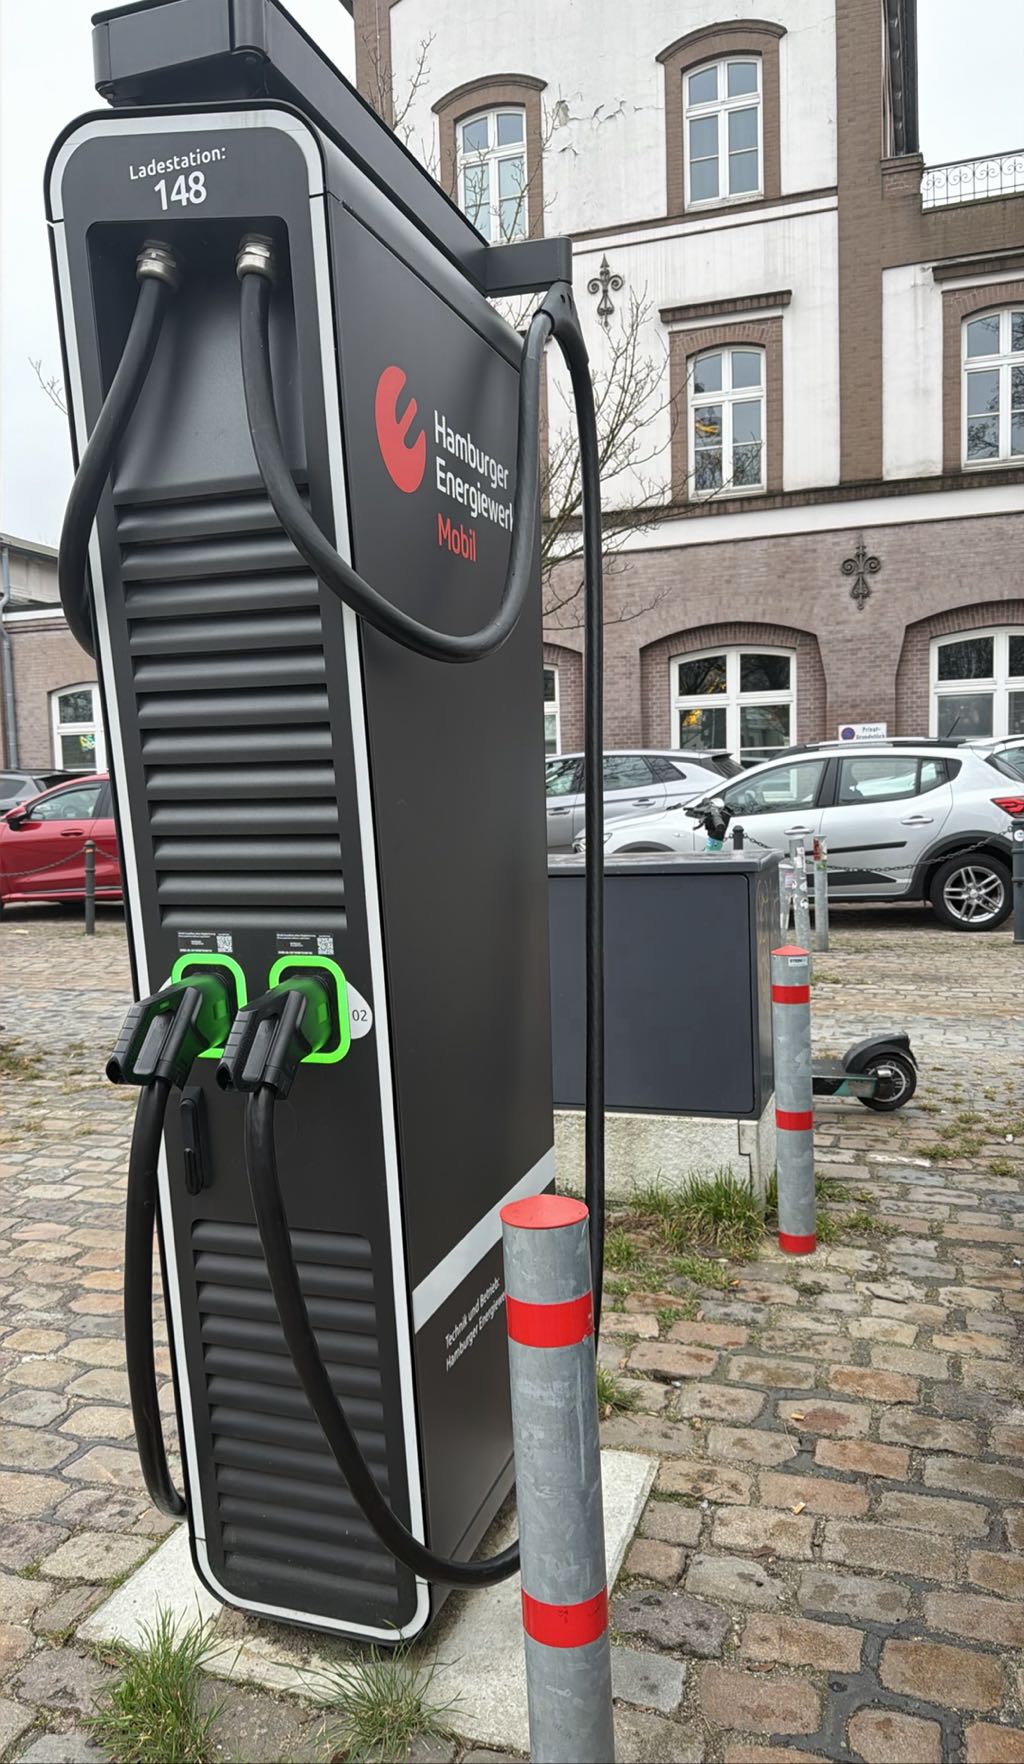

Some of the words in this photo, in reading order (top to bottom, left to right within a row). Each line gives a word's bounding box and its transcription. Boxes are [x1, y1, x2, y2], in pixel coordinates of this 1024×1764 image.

[129, 147, 226, 180] Ladestation:
[154, 170, 207, 211] 148
[434, 409, 509, 490] Hamburger
[437, 512, 477, 562] Mobil
[352, 1009, 368, 1022] 02
[445, 1313, 468, 1350] Technik
[468, 1297, 480, 1322] und
[446, 1323, 479, 1373] Hamburger
